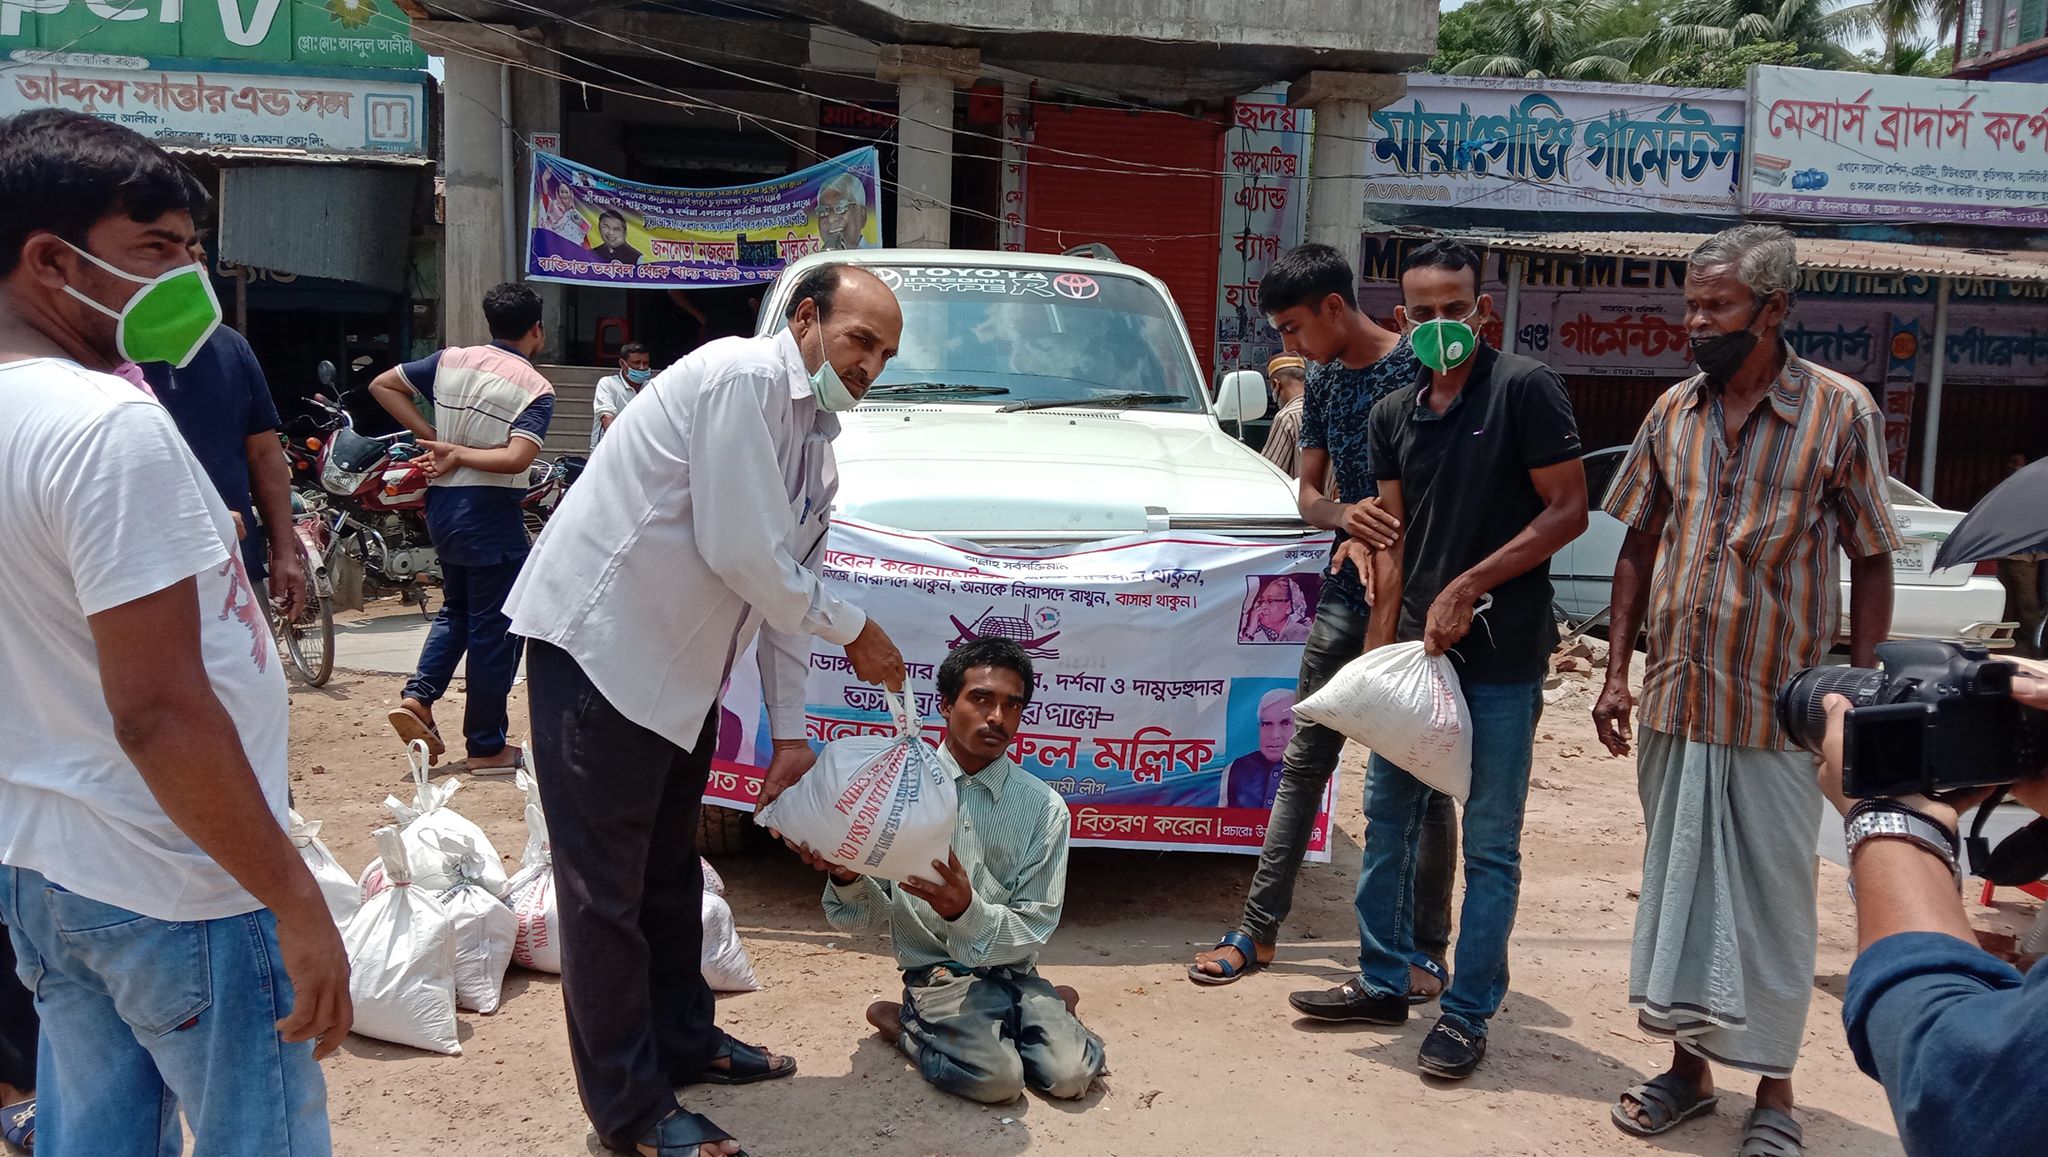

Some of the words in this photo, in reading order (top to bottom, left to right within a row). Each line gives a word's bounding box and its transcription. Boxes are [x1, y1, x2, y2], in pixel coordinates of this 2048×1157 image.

[338, 37, 375, 58] আব্দুল
[377, 34, 414, 56] আলীম
[15, 68, 125, 112] আব্দুস
[131, 73, 232, 114] সাত্তার
[232, 86, 292, 116] এন্ড
[1235, 103, 1297, 132] হৃদয়
[1768, 88, 1874, 143] মেসার্স
[1874, 94, 1979, 152] ব্রাদার্স
[1583, 102, 1744, 196] গার্মেন্টস
[1837, 162, 1859, 173] এখানে
[1849, 183, 1856, 191] ও
[1858, 182, 1876, 192] সকল
[1877, 183, 1897, 194] প্রকার
[1925, 184, 1944, 196] পাইপ
[651, 239, 695, 265] জননেতা
[697, 241, 737, 266] নজরুল
[1233, 232, 1281, 263] ব্যাগ
[538, 253, 591, 273] ব্যক্তিগত
[591, 259, 634, 278] তহবিল
[636, 262, 670, 280] থেকে
[671, 264, 701, 281] খাদ্য
[902, 267, 1048, 280] TOYOTA
[904, 282, 1007, 294] TYPE
[1009, 279, 1056, 297] R
[964, 553, 1000, 569] আল্লাহ
[1002, 559, 1069, 572] সর্বশক্তিমান
[1284, 549, 1299, 560] জয়
[1152, 568, 1205, 588] থাকুন,
[912, 577, 956, 595] থাকুন,
[960, 579, 1008, 597] অন্যকে
[1010, 579, 1065, 602] নিরাপদে
[1069, 588, 1111, 608] রাখুন,
[1114, 592, 1152, 607] বাসায়
[1056, 671, 1106, 694] দর্শনা
[1111, 679, 1127, 694] ও
[1132, 679, 1226, 702] দামুড়হুদার
[1093, 725, 1216, 784] মল্লিক
[834, 777, 871, 816] CHINA
[1078, 781, 1106, 797] লীগ
[1076, 807, 1148, 834] বিতরণ
